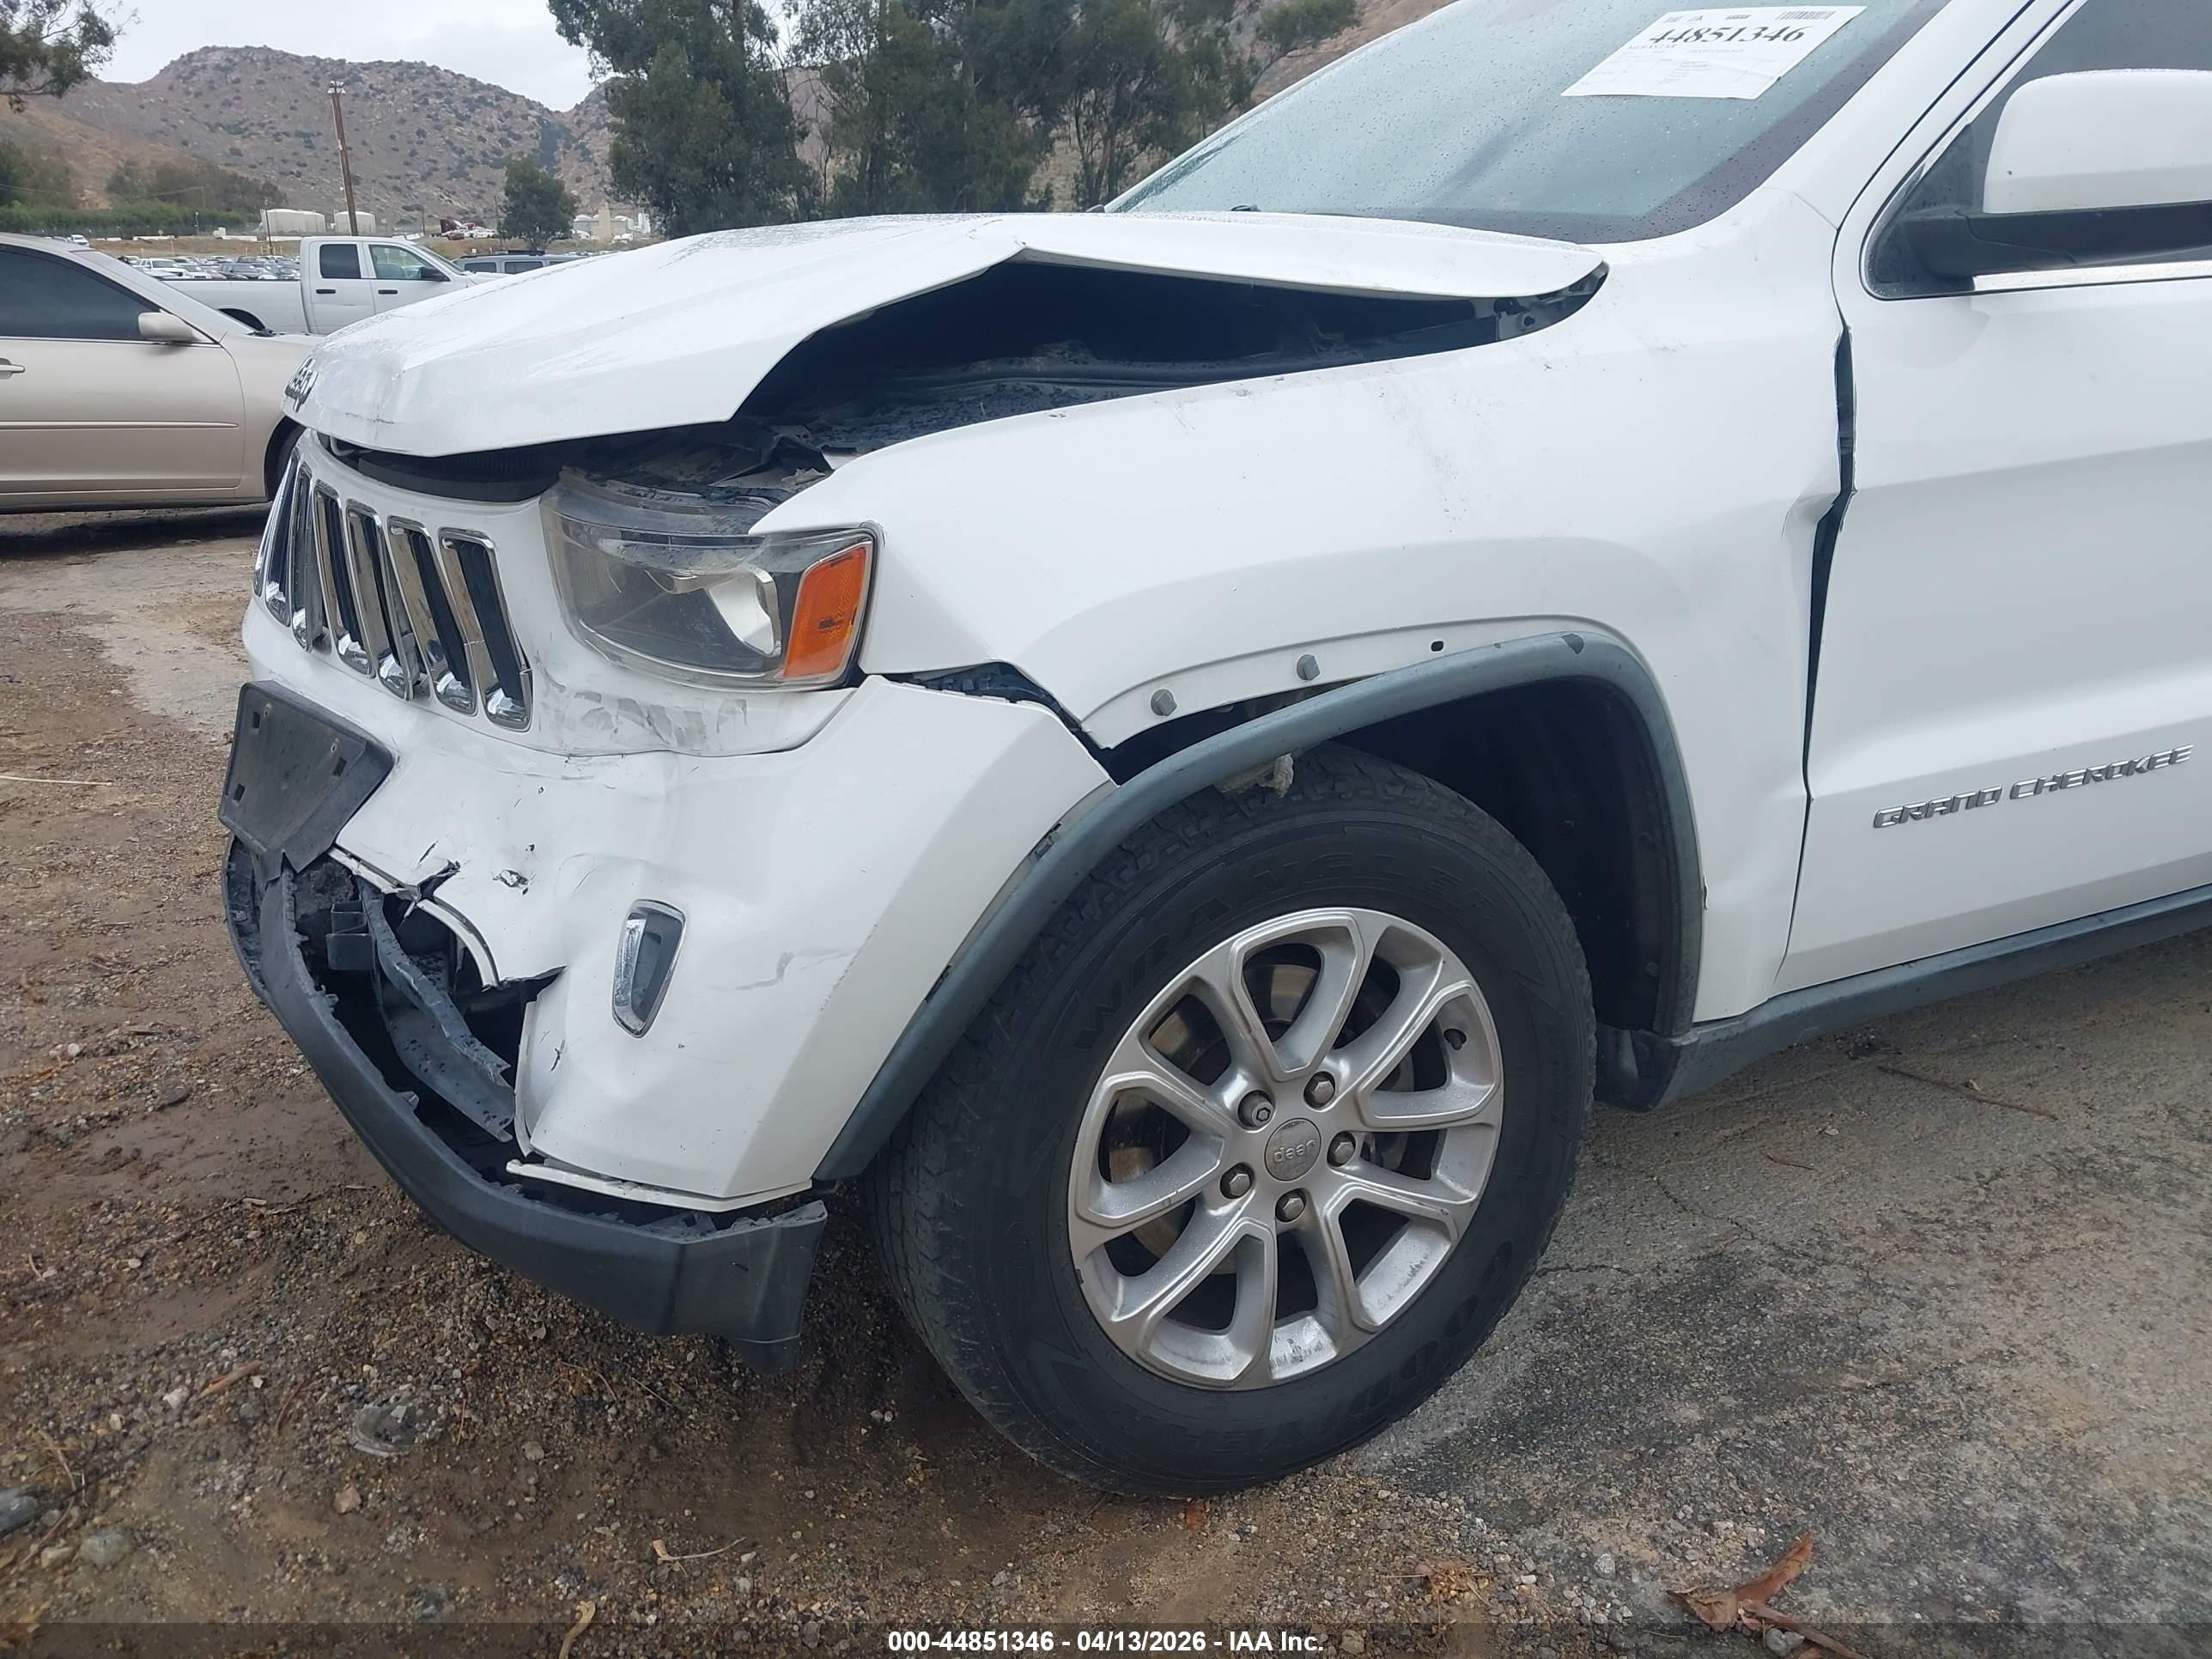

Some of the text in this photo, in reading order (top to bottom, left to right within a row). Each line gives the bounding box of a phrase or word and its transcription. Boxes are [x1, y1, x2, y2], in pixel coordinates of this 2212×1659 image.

[1649, 25, 1814, 44] 44851346
[1873, 744, 2195, 829] GRAND CHEROKEE
